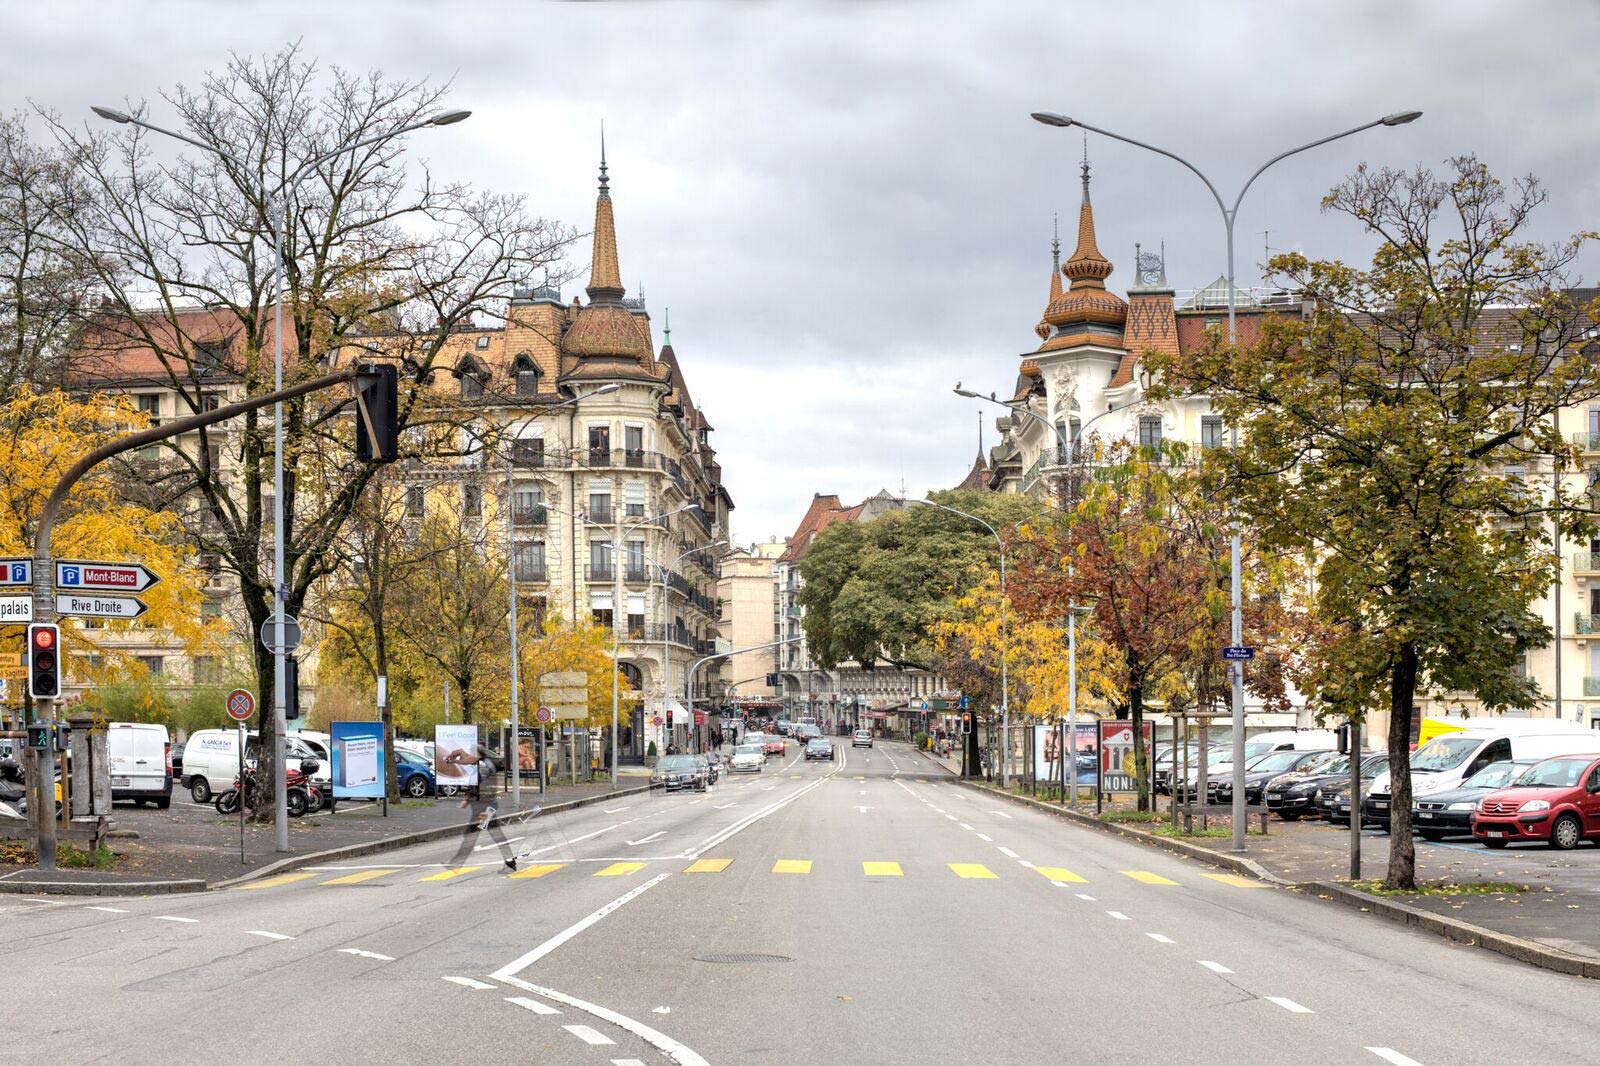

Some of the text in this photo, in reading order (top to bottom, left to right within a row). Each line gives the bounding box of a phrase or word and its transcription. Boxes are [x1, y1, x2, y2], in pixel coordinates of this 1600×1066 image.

[16, 569, 22, 579] P
[67, 572, 135, 583] P Mont-Blanc
[1, 600, 29, 618] palais
[71, 599, 122, 613] Rive Droite
[5, 669, 27, 678] Sagitta
[1104, 776, 1133, 790] NON!
